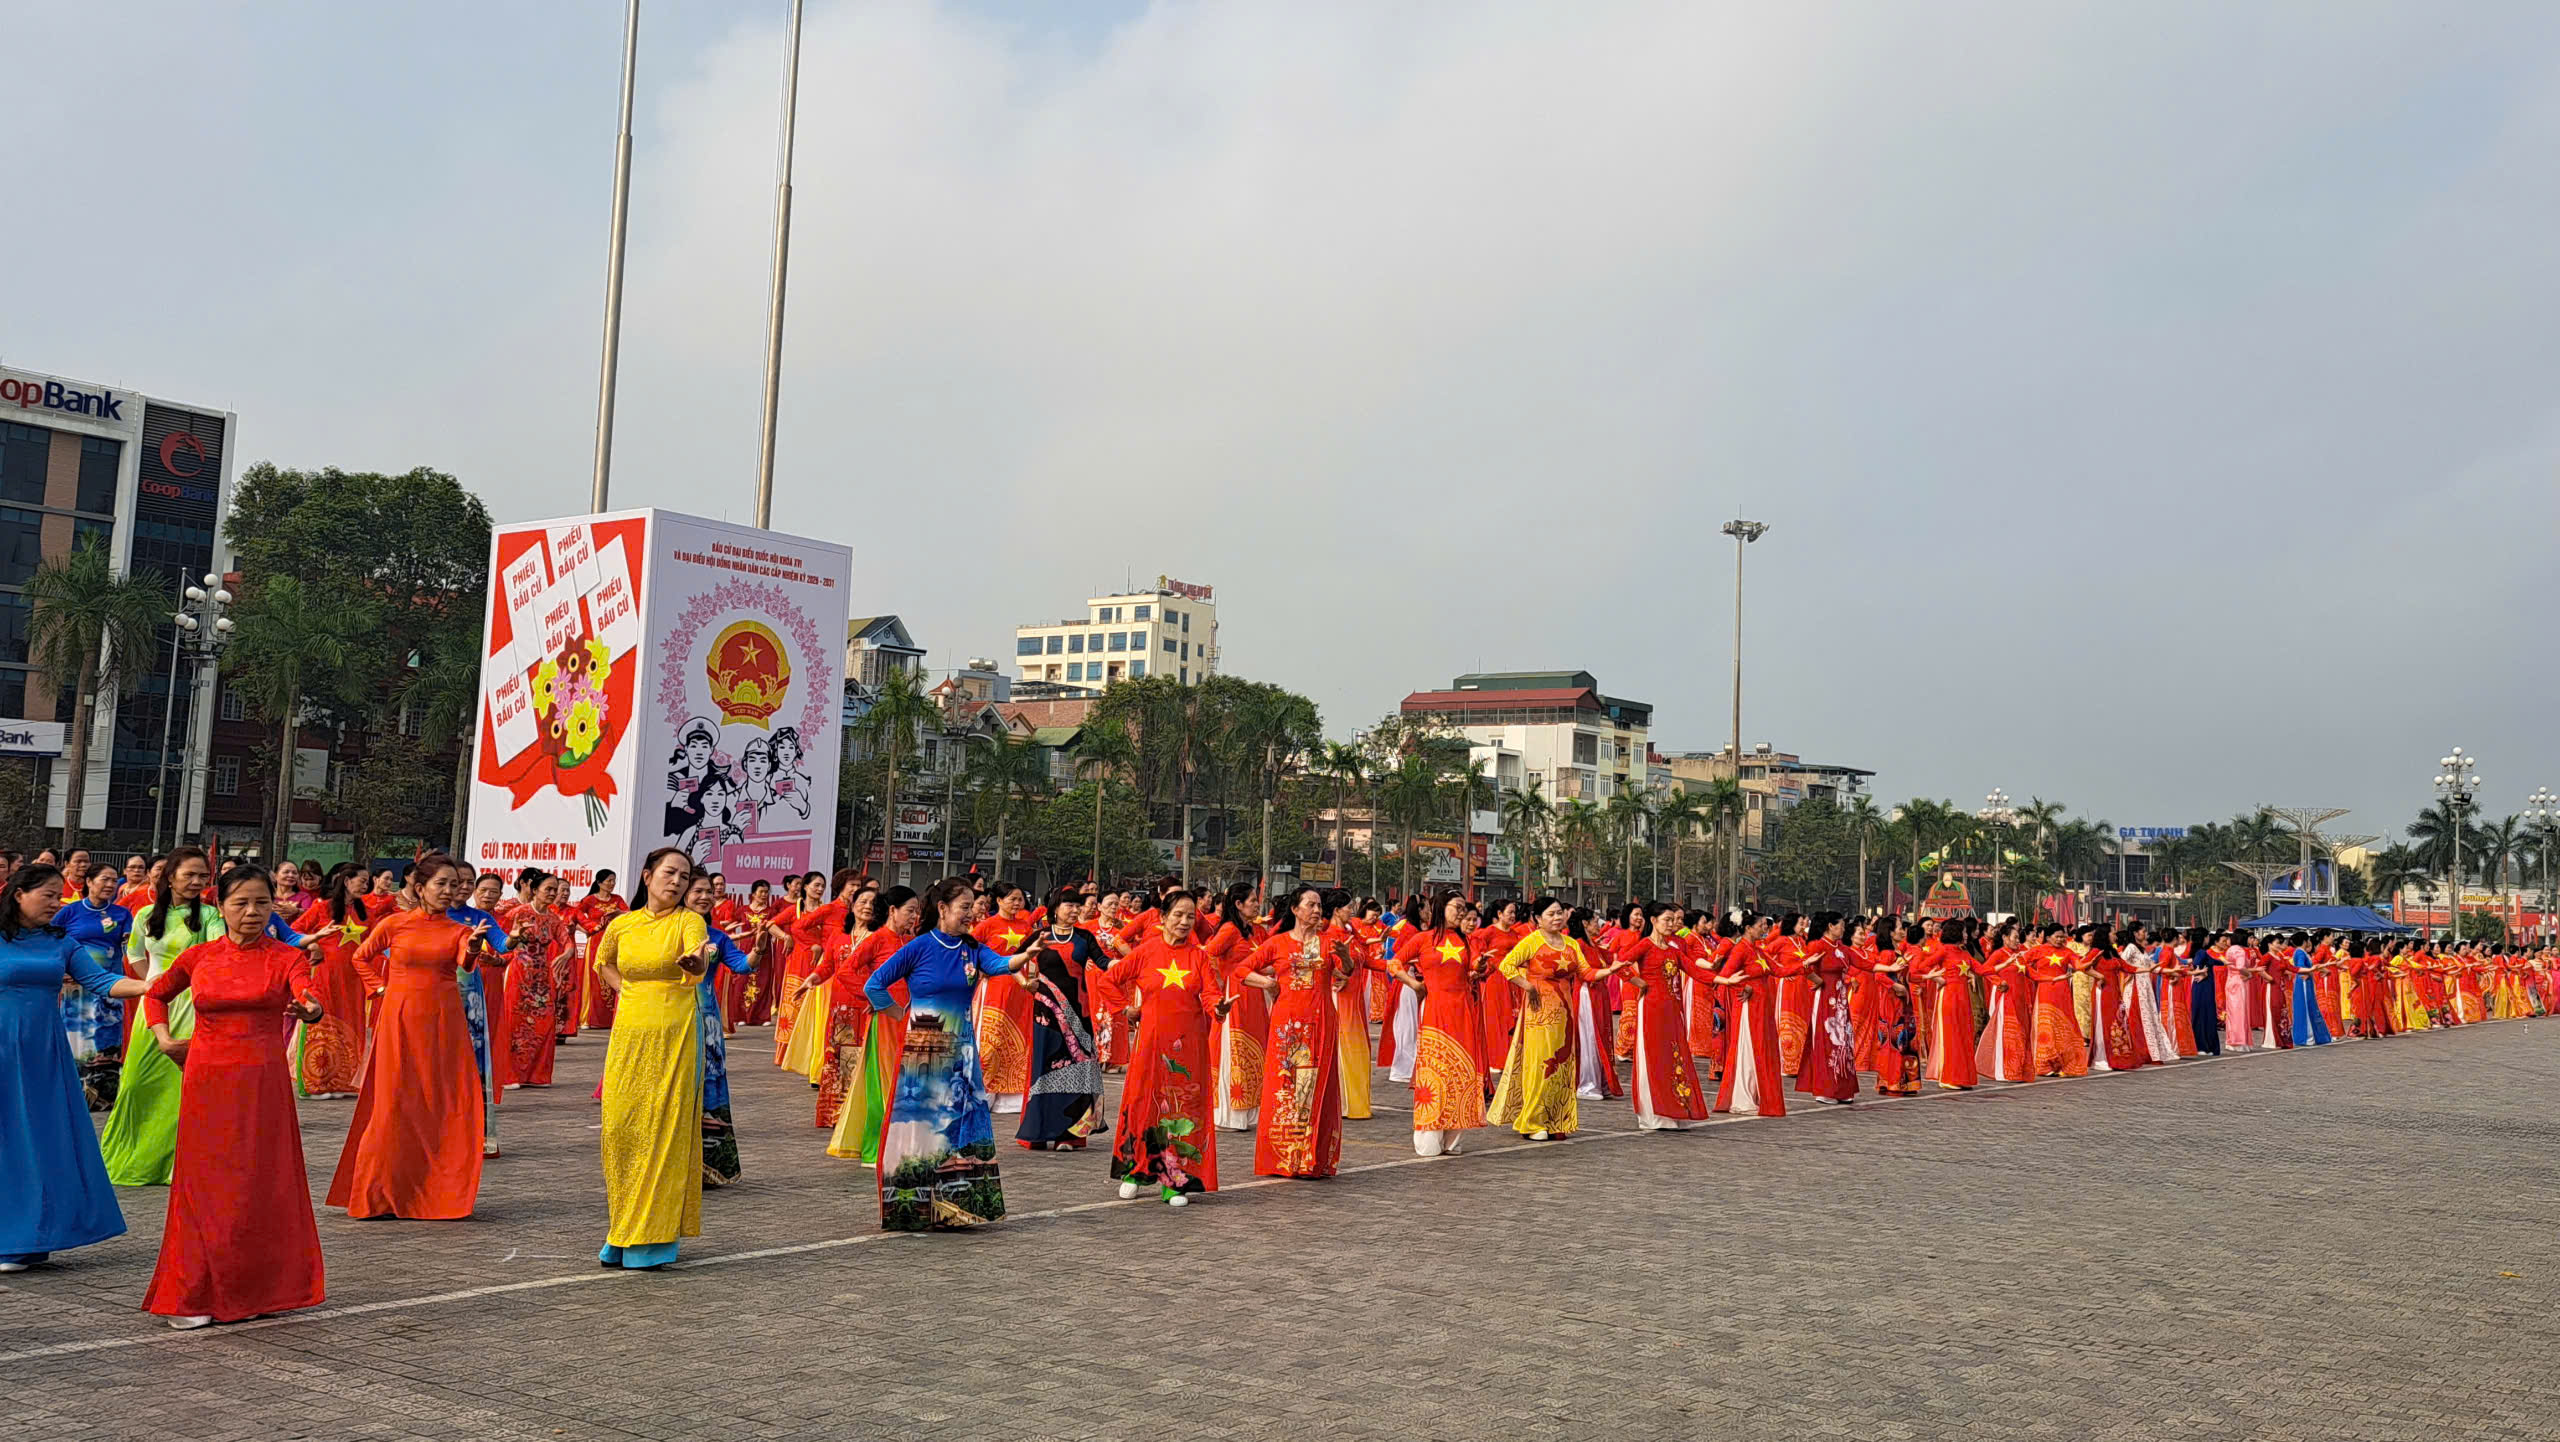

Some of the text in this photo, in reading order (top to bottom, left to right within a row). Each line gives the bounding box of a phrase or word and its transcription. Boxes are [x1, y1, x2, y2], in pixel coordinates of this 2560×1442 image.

[142, 480, 216, 502] Co-opBank
[557, 525, 582, 555] PHIẾU
[512, 559, 536, 589] PHIẾU
[597, 576, 622, 607] PHIẾU
[545, 600, 569, 630] PHIẾU
[496, 673, 520, 705] PHIẾU
[2119, 827, 2136, 837] GA
[560, 842, 577, 860] TIN
